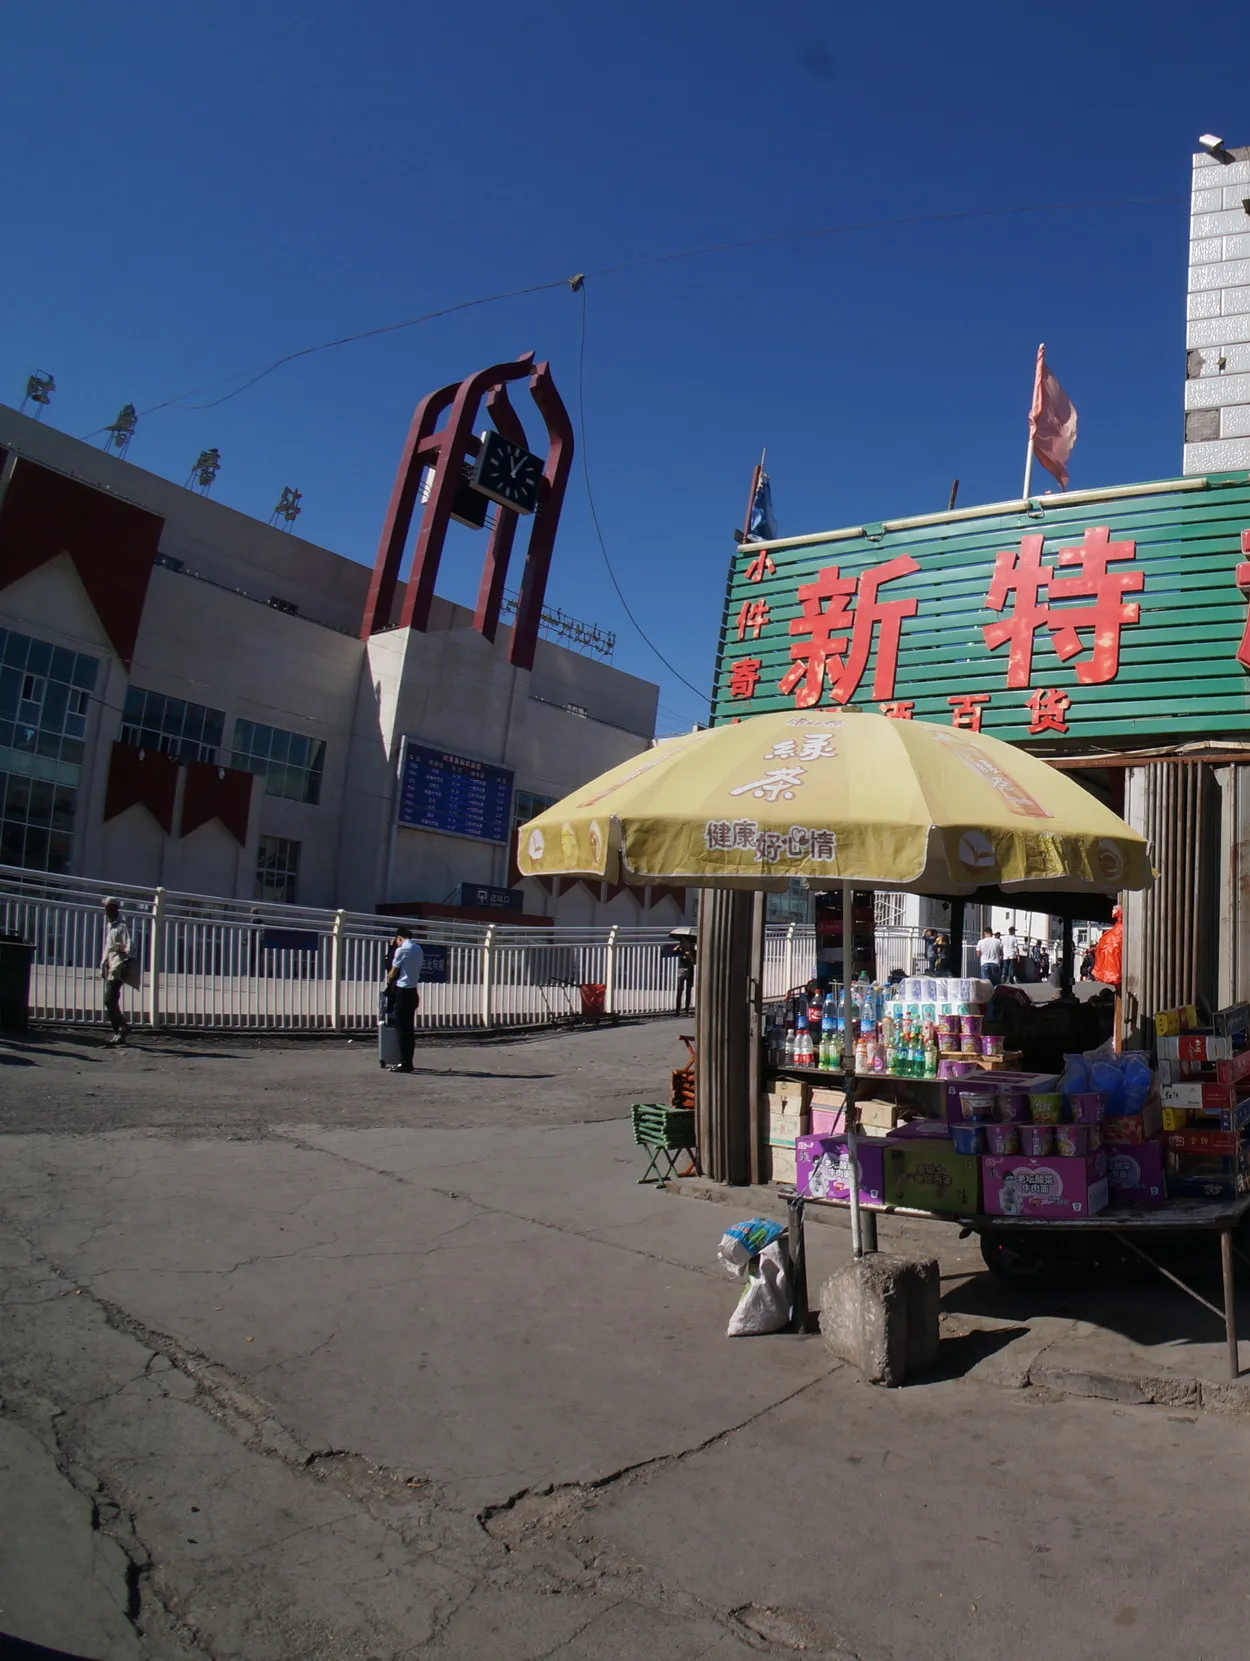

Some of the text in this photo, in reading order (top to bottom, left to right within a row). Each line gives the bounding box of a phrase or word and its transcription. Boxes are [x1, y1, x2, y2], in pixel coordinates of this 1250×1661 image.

[729, 549, 776, 725] 小件寄
[704, 818, 836, 863] 健康好心情
